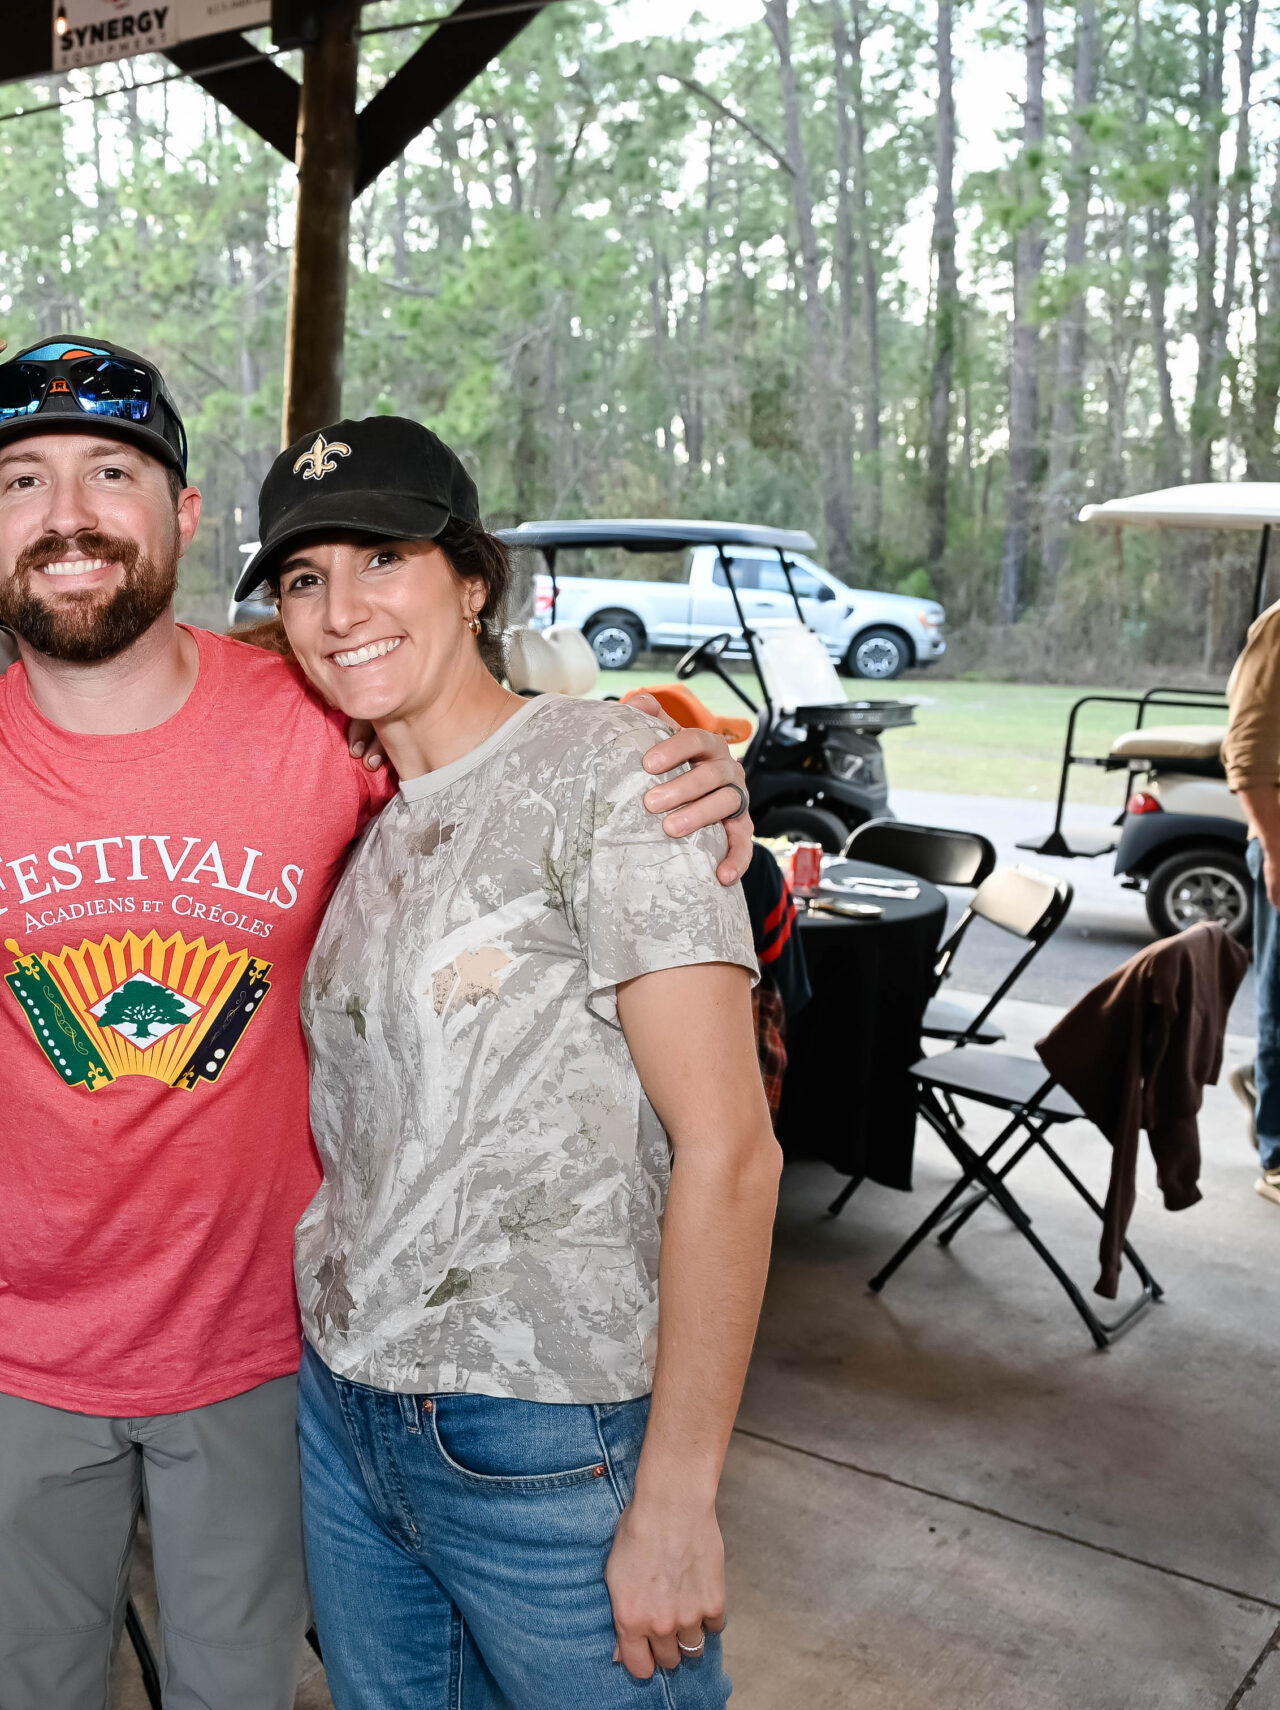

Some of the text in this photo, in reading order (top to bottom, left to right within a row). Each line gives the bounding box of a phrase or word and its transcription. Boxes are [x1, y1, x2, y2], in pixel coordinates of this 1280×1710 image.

[60, 6, 169, 52] SYNERGY
[61, 31, 167, 67] EQUIPMENT
[24, 894, 274, 938] ACADIENS ET CRÉOLES
